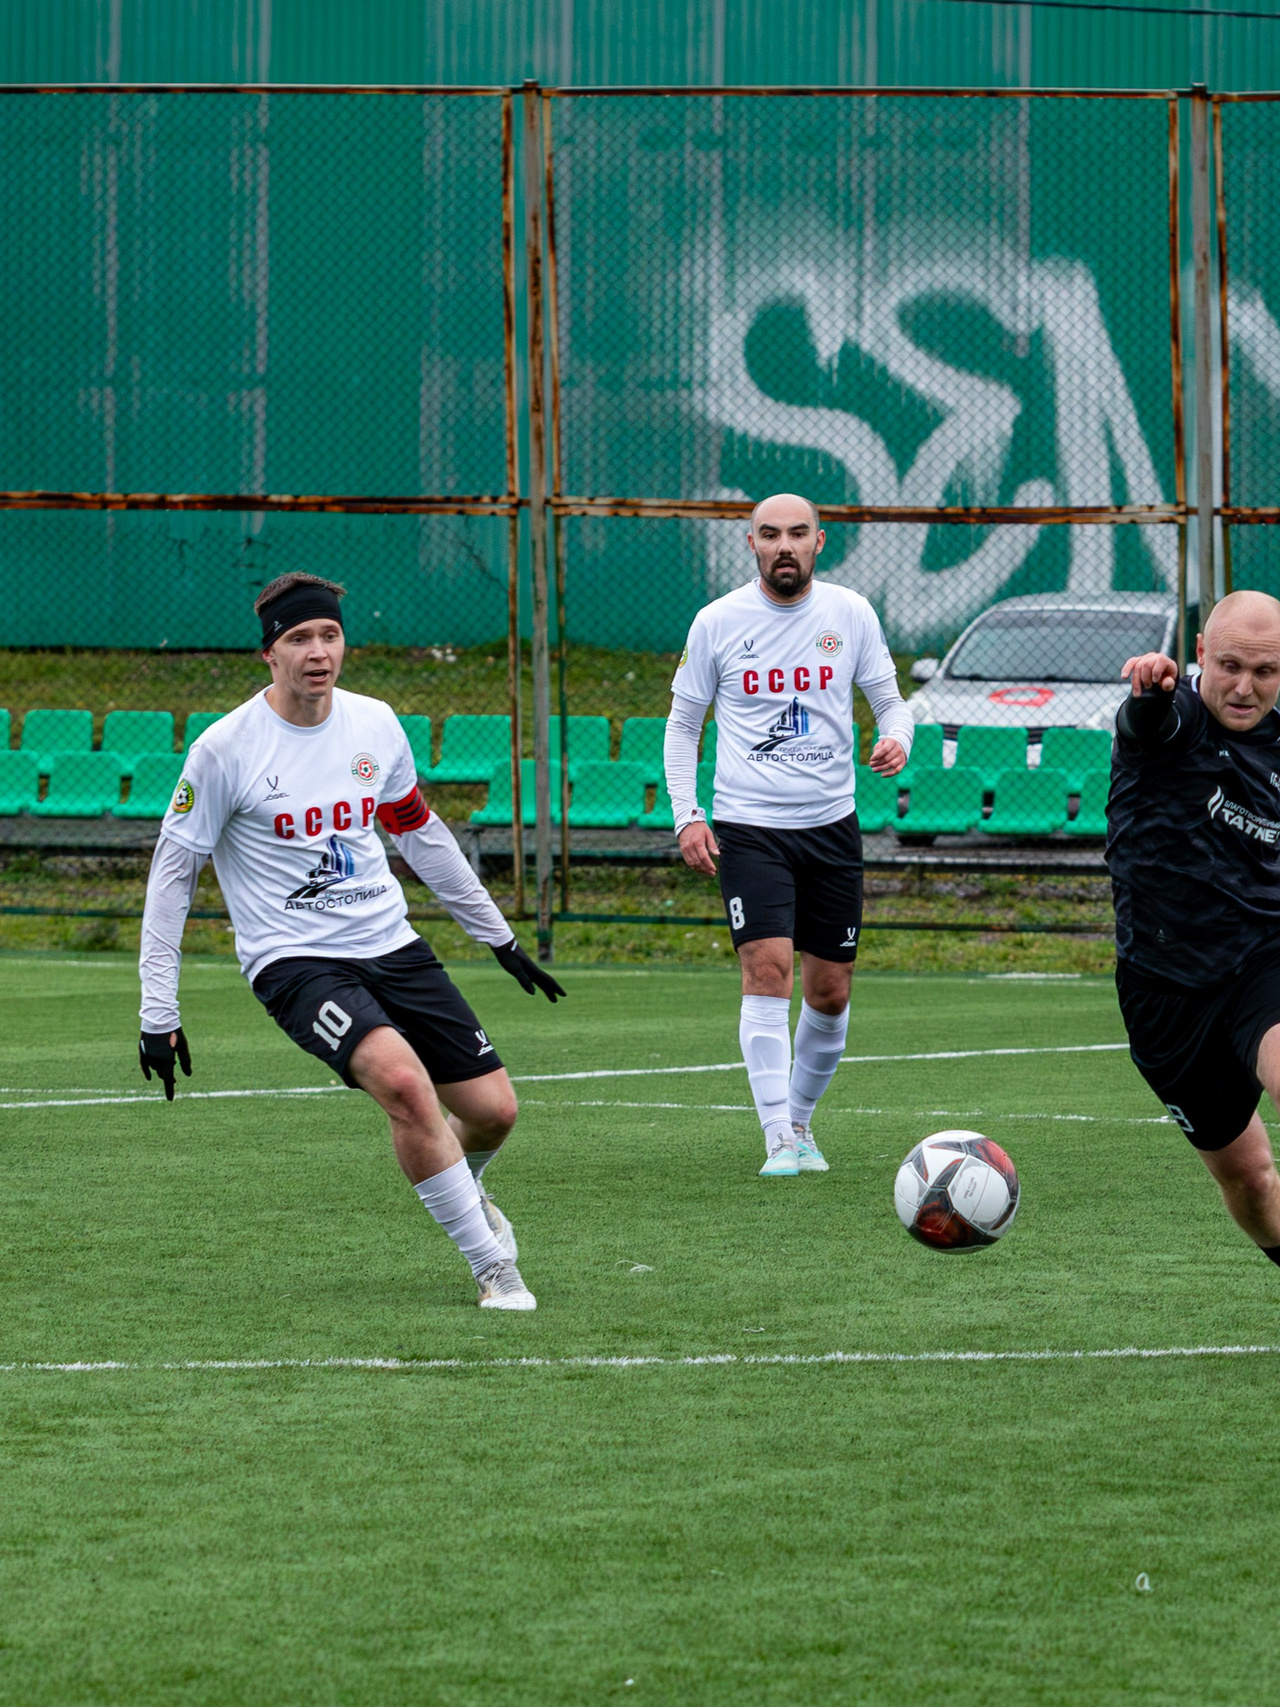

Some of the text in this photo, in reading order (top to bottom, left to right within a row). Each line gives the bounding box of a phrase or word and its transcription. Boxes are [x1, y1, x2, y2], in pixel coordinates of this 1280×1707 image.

[743, 666, 833, 695] СССР
[746, 751, 834, 762] АВТОСТОЛИЦА
[274, 797, 375, 840] СССР
[1221, 807, 1280, 843] TATNE
[284, 884, 388, 911] АВТОСТОЛИЦА
[729, 896, 746, 931] 8
[312, 1000, 353, 1052] 10
